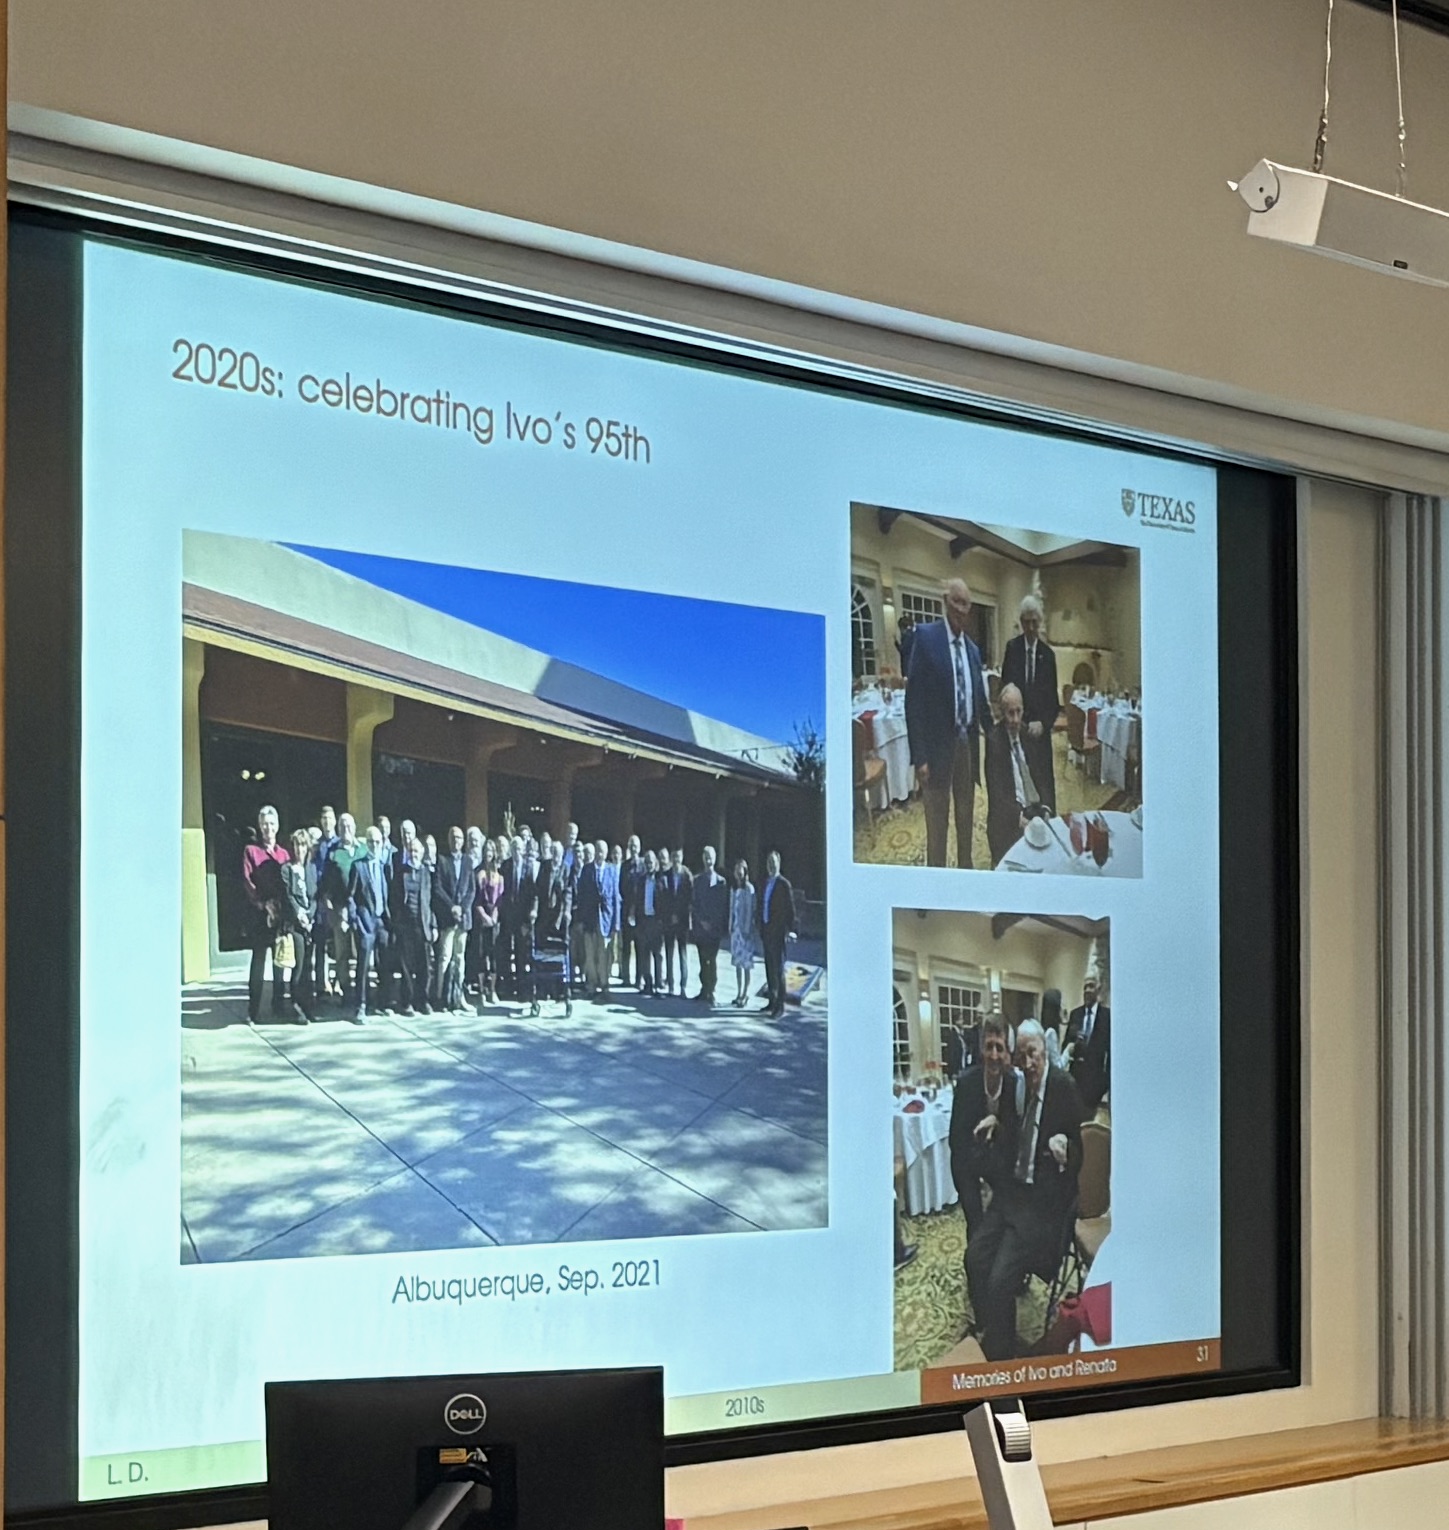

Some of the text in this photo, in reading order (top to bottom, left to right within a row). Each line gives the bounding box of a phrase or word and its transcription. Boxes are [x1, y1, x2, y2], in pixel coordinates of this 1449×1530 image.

[172, 338, 651, 464] 2020s: celebrating Ivo's 95th
[1137, 492, 1196, 525] TEXAS
[391, 1259, 660, 1305] Albuquerque, Sep. 2021
[1197, 1345, 1209, 1362] 31
[952, 1358, 1117, 1390] Memories of Ivo and Renata
[449, 1408, 484, 1420] DELL
[725, 1395, 765, 1417] 2010s
[129, 1461, 149, 1483] D.
